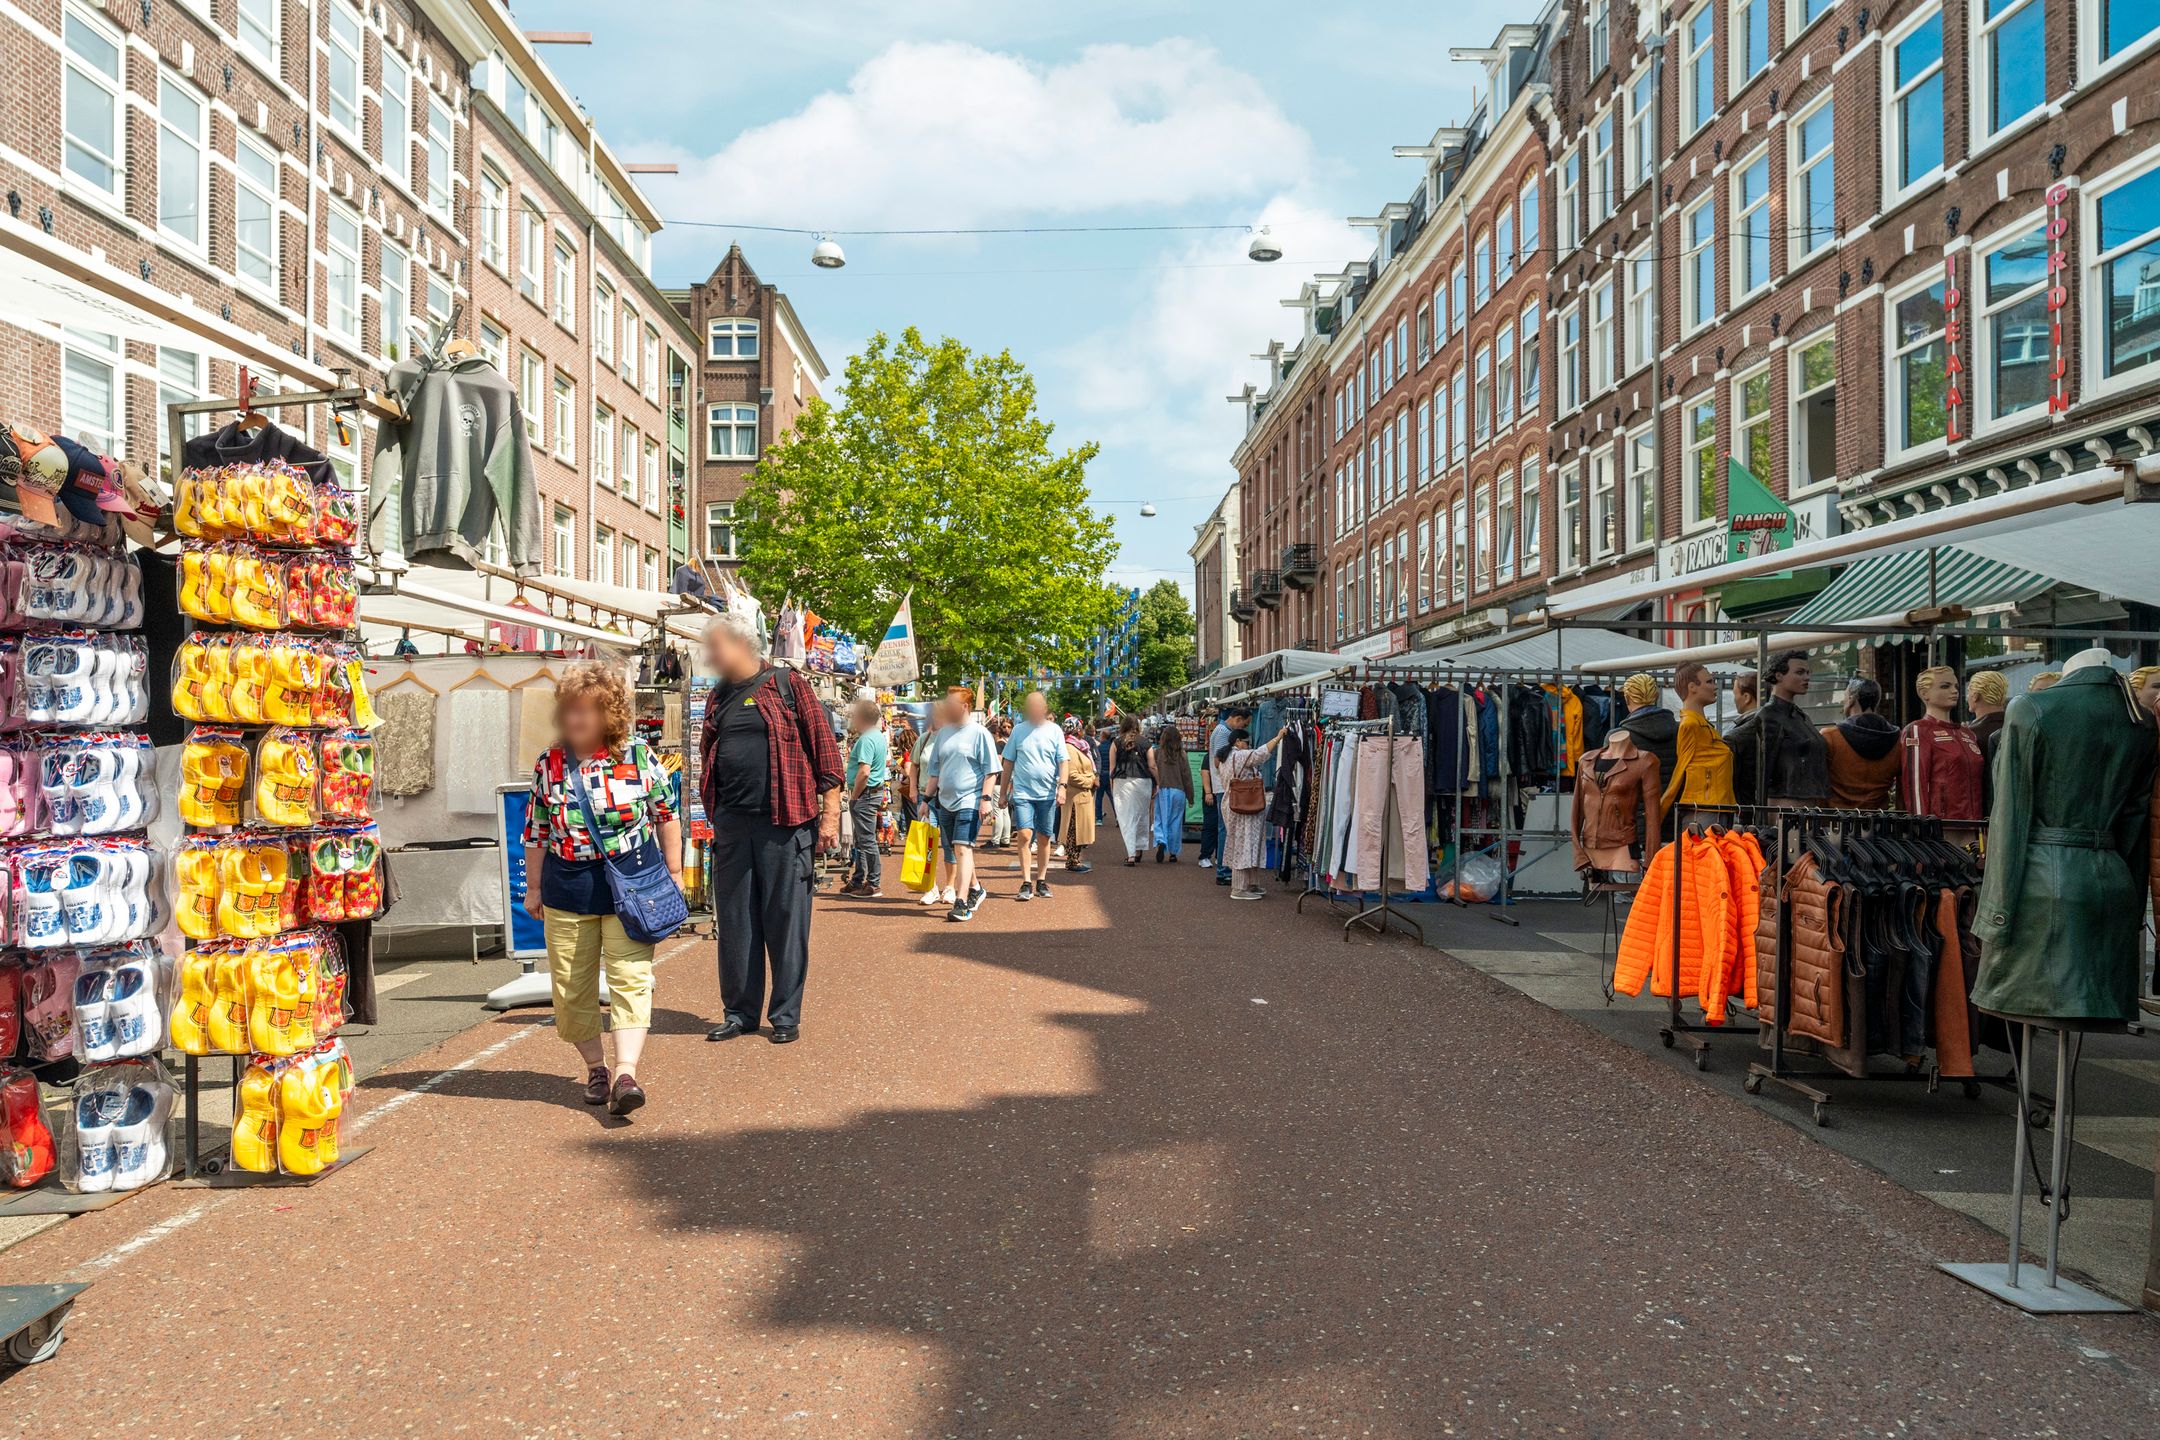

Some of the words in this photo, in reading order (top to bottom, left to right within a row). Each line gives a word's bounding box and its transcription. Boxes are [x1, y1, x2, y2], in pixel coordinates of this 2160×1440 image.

[1945, 255, 1964, 442] IDEAAL
[2046, 183, 2069, 414] GORDIJN
[1731, 511, 1788, 531] RANCHI
